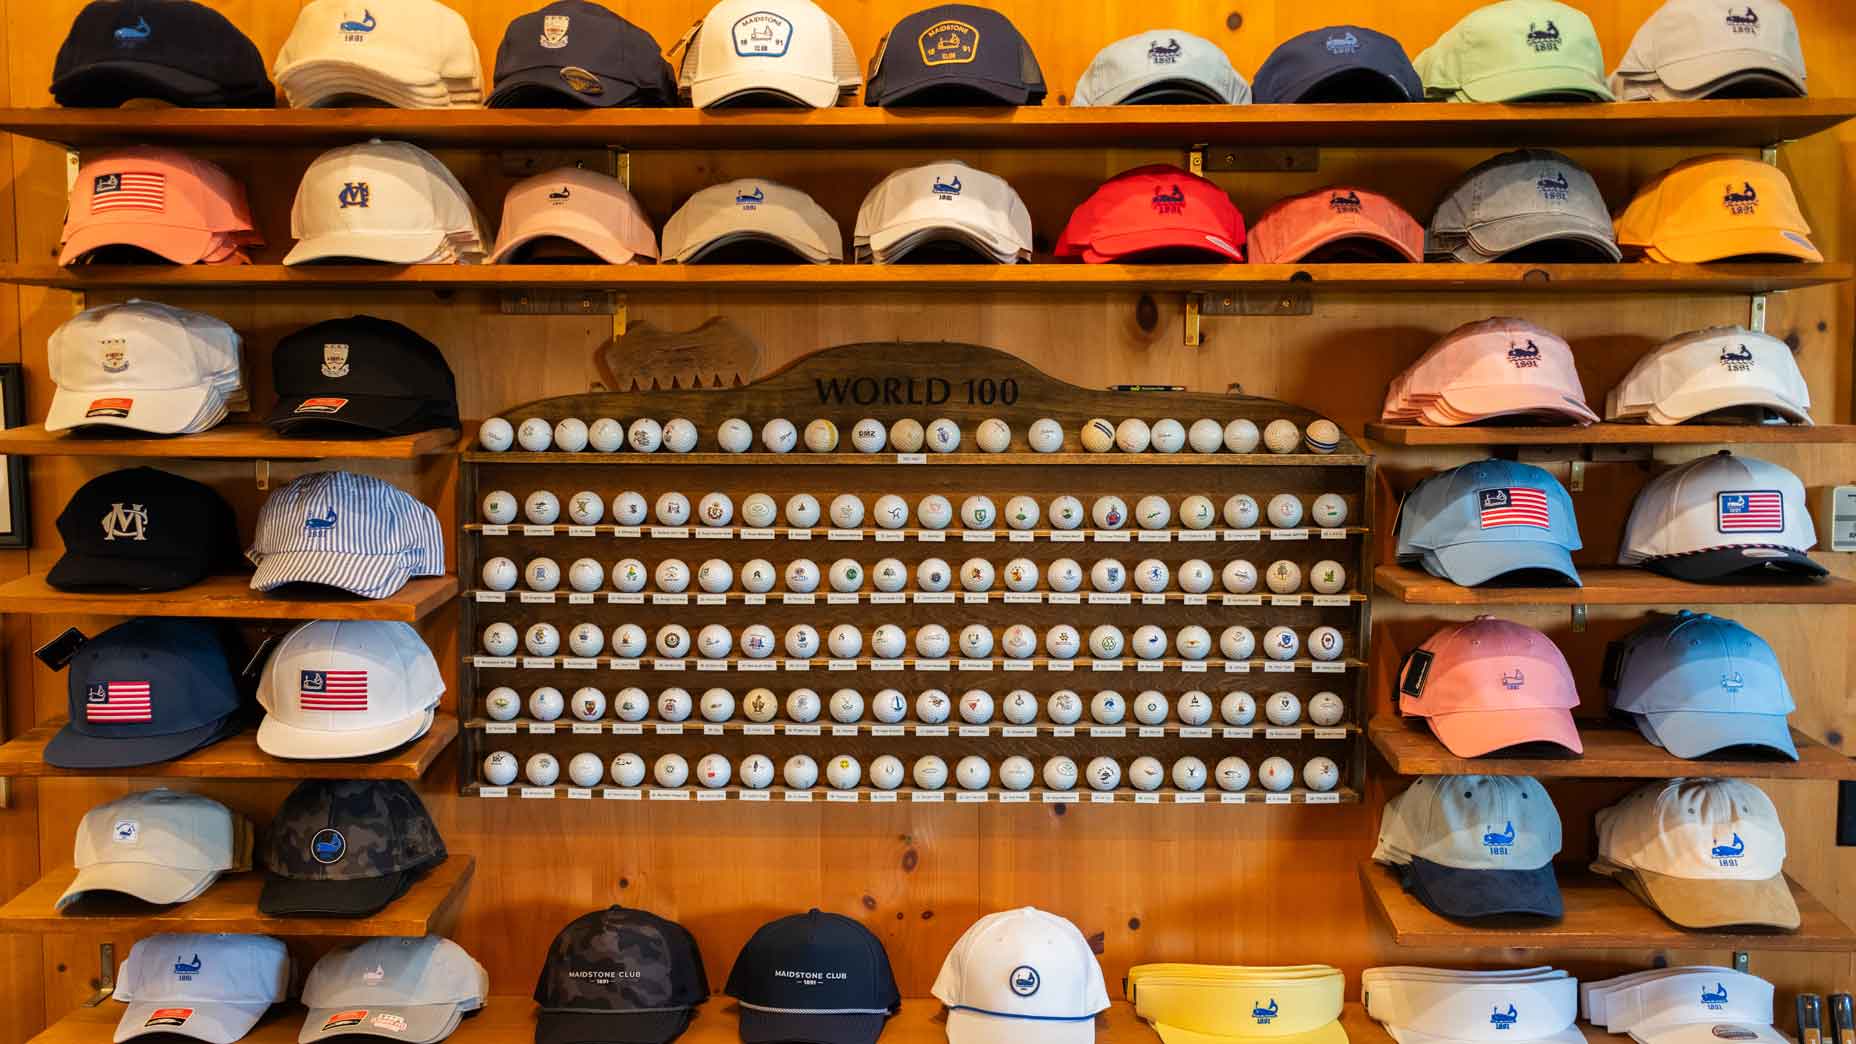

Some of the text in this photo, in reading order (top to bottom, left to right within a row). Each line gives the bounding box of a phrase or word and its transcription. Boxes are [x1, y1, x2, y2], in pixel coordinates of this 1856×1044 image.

[741, 16, 782, 26] MAIDSTONE
[927, 24, 969, 37] MAIDSTONE
[1731, 206, 1754, 215] 1891
[1515, 360, 1538, 369] 1891
[1727, 364, 1751, 372] 1891
[815, 376, 1019, 405] WORLD 100
[1489, 847, 1508, 855] 1891
[1719, 859, 1738, 867] 1891
[774, 969, 823, 979] MAIDSTONE
